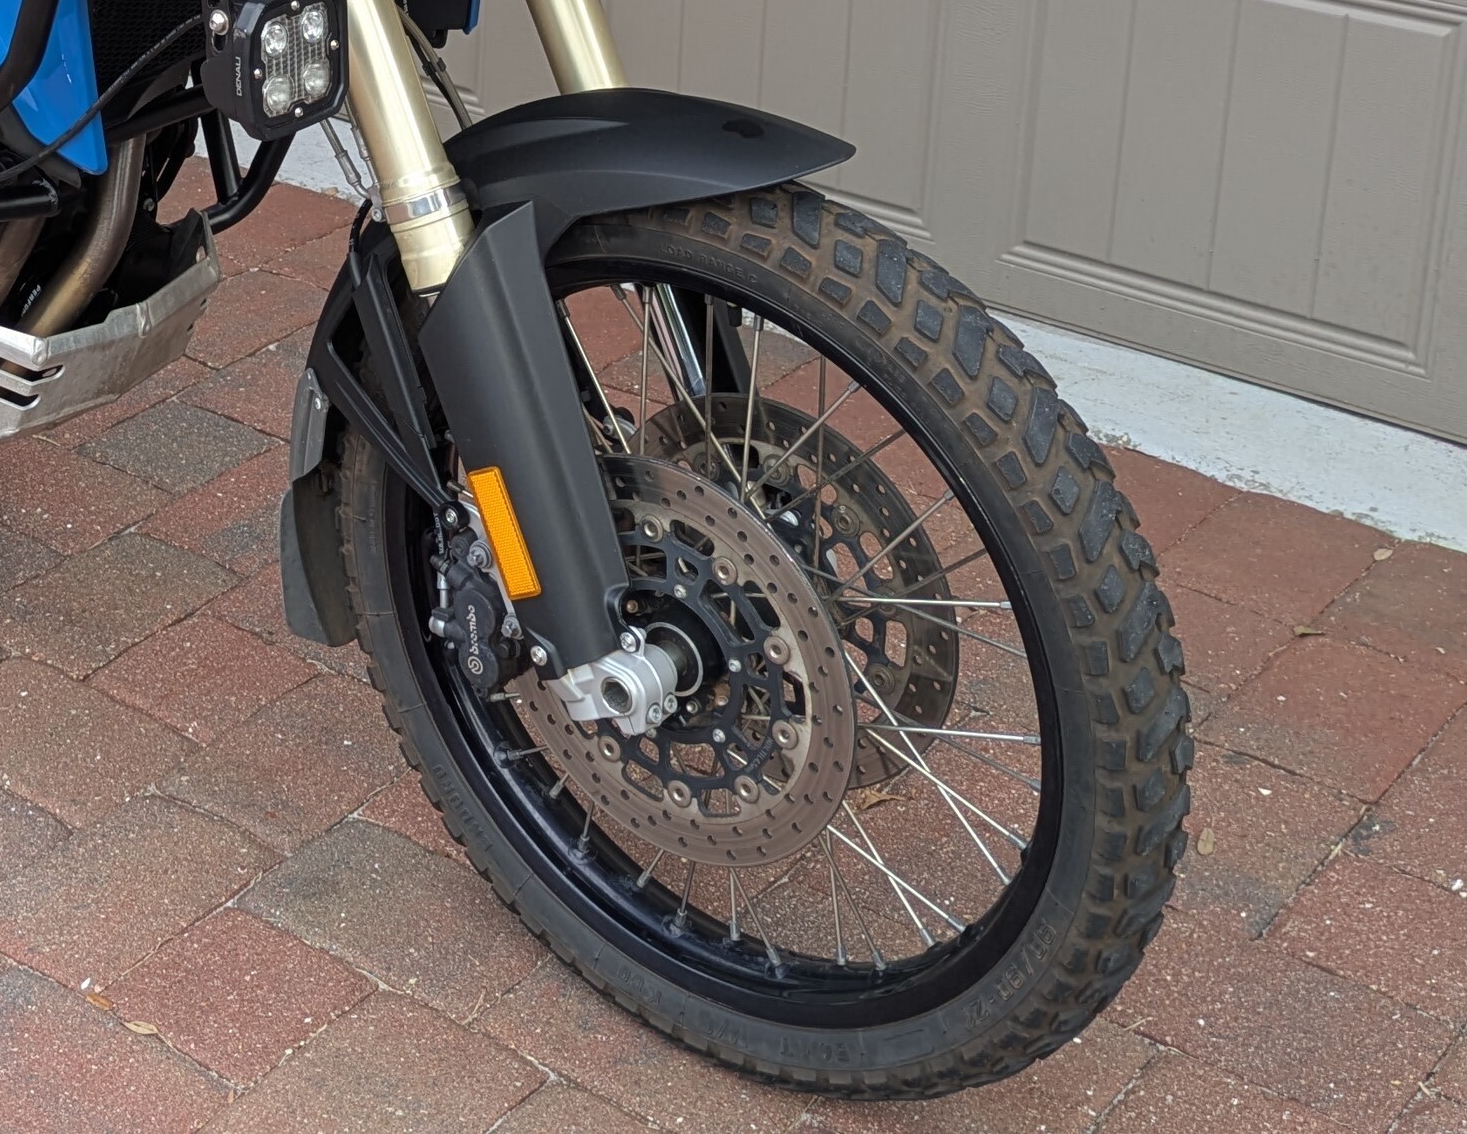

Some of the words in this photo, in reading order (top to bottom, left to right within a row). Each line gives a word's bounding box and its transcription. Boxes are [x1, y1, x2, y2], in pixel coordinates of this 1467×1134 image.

[235, 56, 243, 97] DENALI
[660, 243, 693, 260] LOAD
[700, 250, 744, 282] RANGE
[468, 604, 476, 656] brembo
